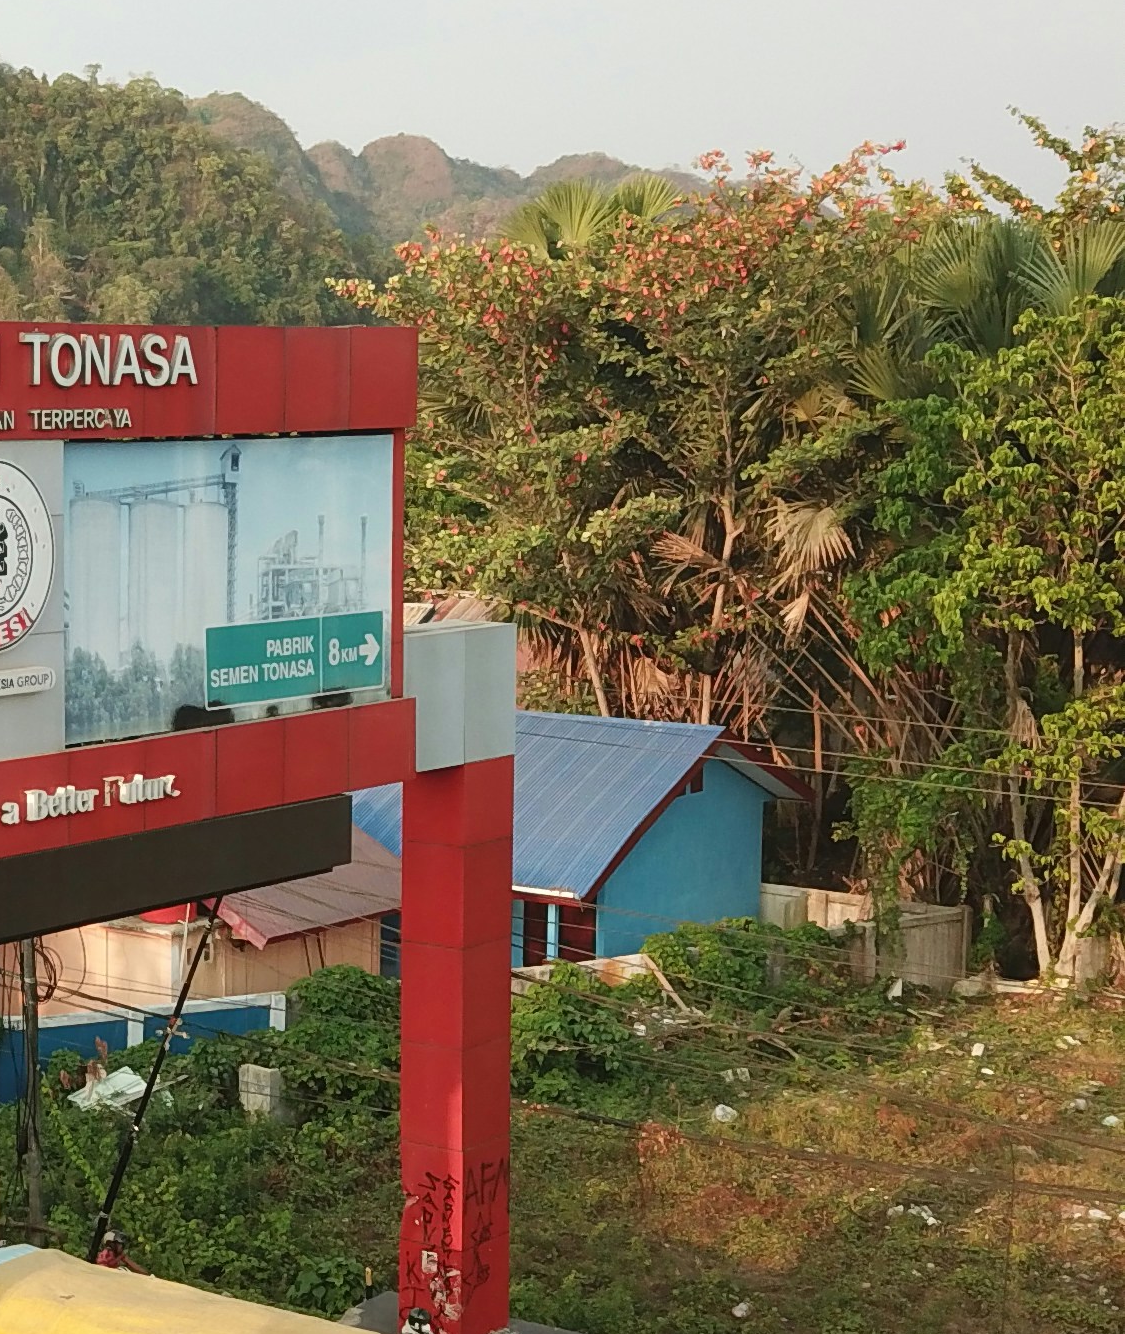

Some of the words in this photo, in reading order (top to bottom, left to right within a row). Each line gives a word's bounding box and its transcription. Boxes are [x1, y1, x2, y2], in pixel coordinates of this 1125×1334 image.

[19, 329, 198, 387] TONASA
[266, 634, 315, 658] PABRIK
[328, 638, 340, 666] 8
[341, 647, 358, 663] KM
[210, 666, 259, 688] SEMEN
[262, 658, 315, 681] TONASA
[1, 801, 20, 825] a
[24, 785, 100, 822] Better
